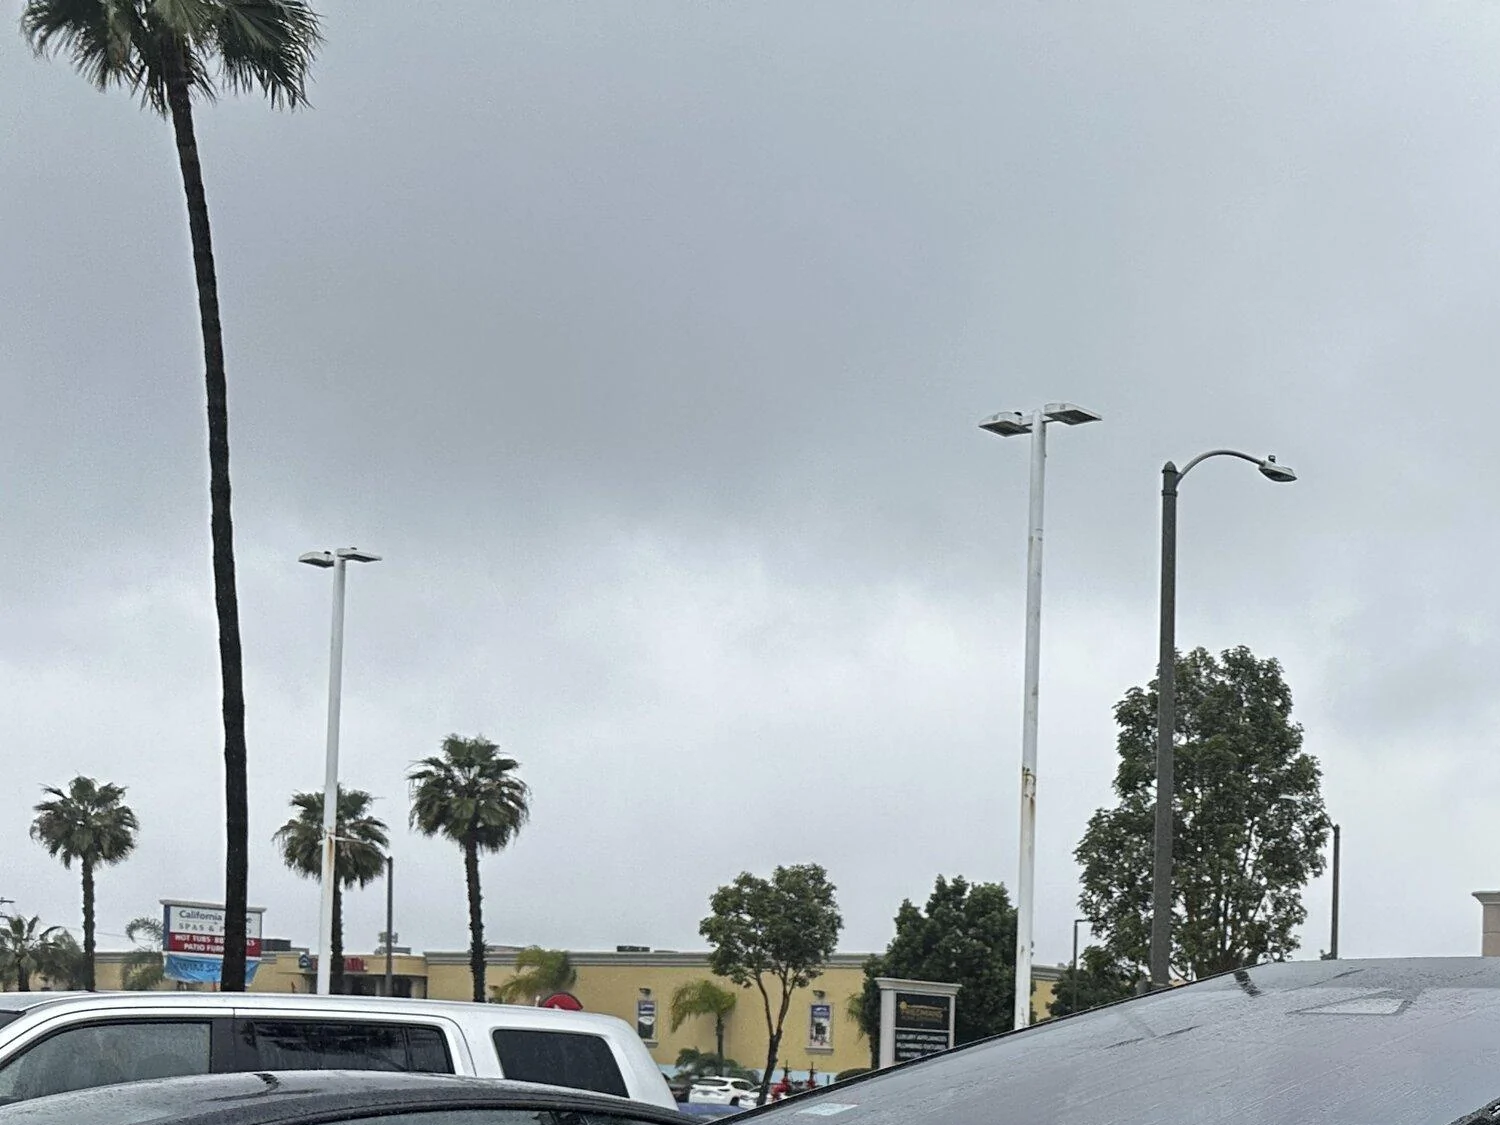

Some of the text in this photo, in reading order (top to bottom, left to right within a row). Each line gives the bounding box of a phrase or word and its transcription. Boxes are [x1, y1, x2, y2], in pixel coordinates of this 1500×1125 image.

[179, 910, 223, 921] California
[179, 923, 204, 931] SPAS
[184, 943, 205, 951] PATIO
